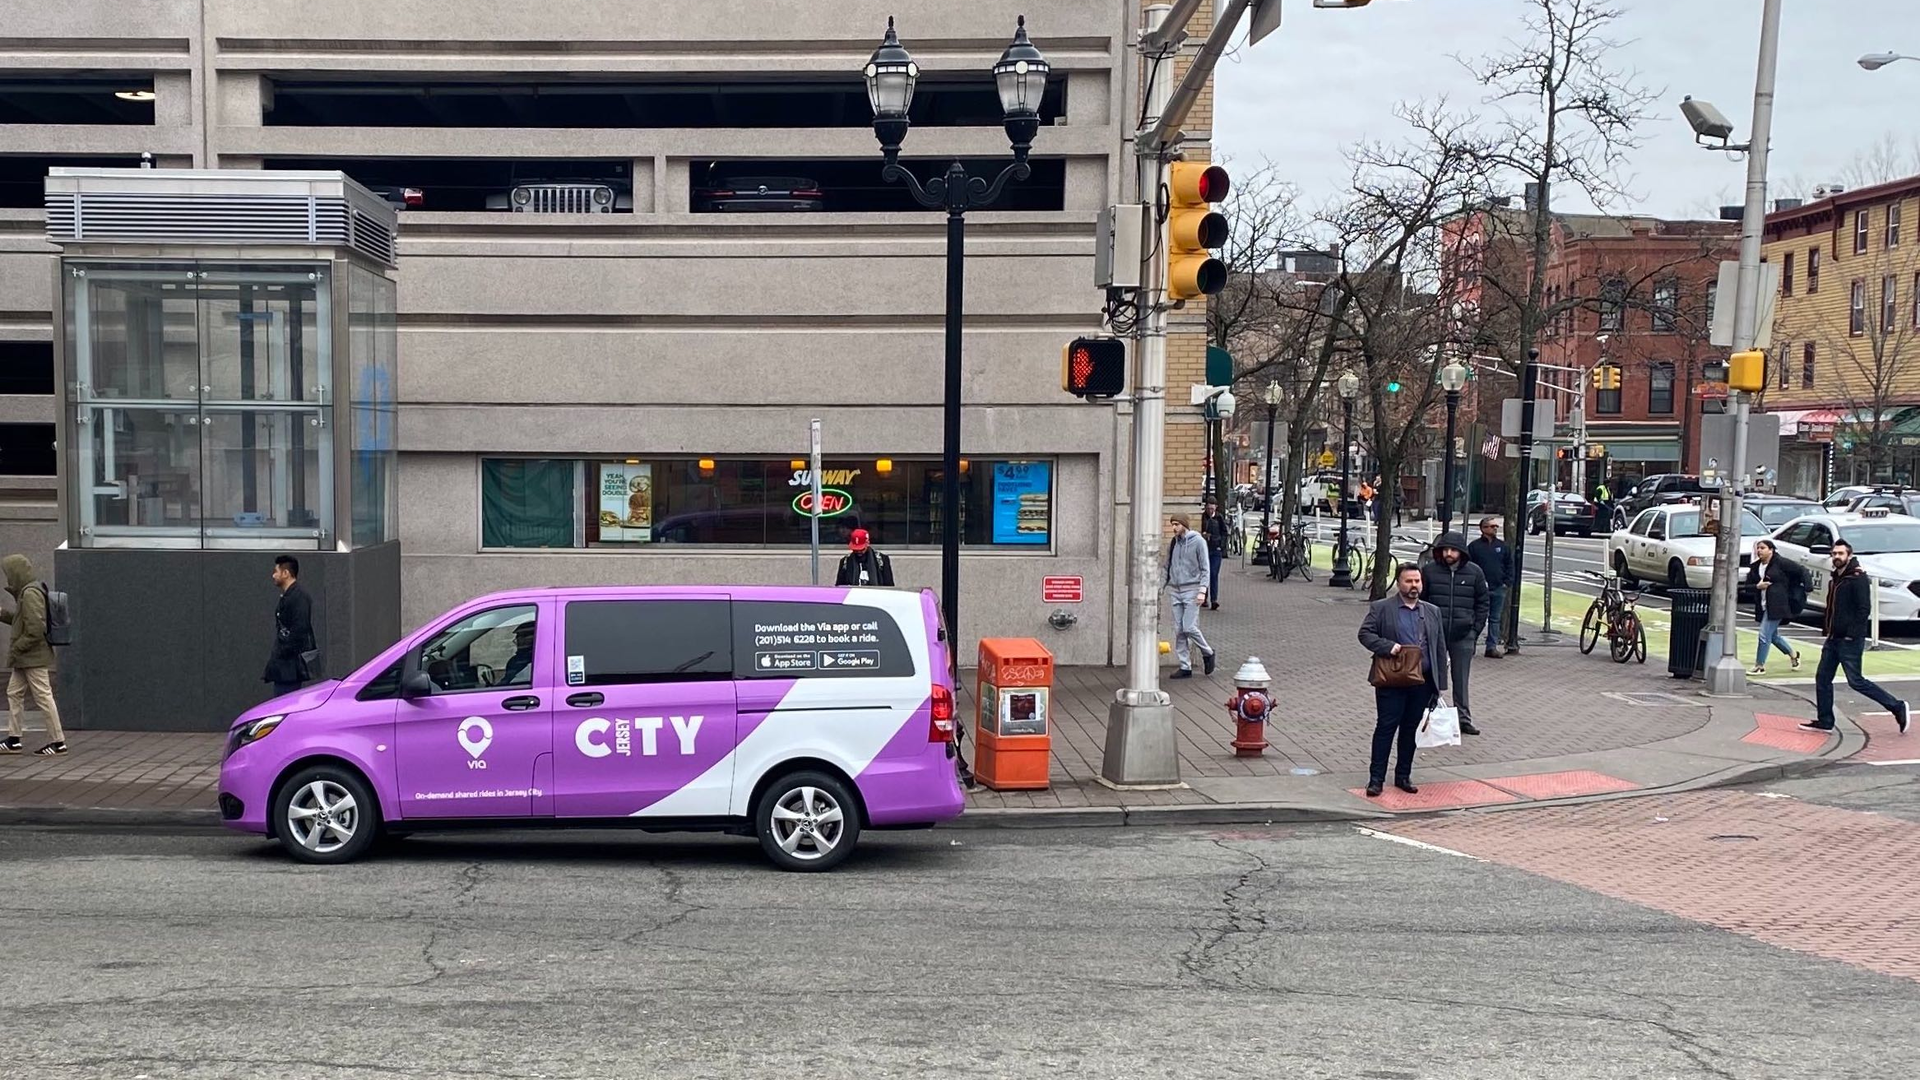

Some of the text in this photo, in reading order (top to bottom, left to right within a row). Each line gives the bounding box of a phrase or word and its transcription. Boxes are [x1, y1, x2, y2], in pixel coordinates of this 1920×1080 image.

[788, 469, 861, 486] SUWAY
[801, 495, 844, 510] OEN
[755, 623, 798, 632] Download
[800, 623, 816, 631] the
[816, 622, 831, 631] Via
[832, 624, 850, 633] app
[862, 621, 878, 630] call
[755, 635, 791, 646] (201)514
[794, 635, 814, 644] 6228
[816, 635, 826, 643] to
[828, 634, 850, 643] book
[859, 634, 879, 642] ride.
[774, 659, 811, 668] App Store
[838, 658, 874, 666] Google Play
[615, 718, 631, 756] JERSEY
[415, 791, 454, 799] On-demand
[504, 790, 527, 798] Jersey
